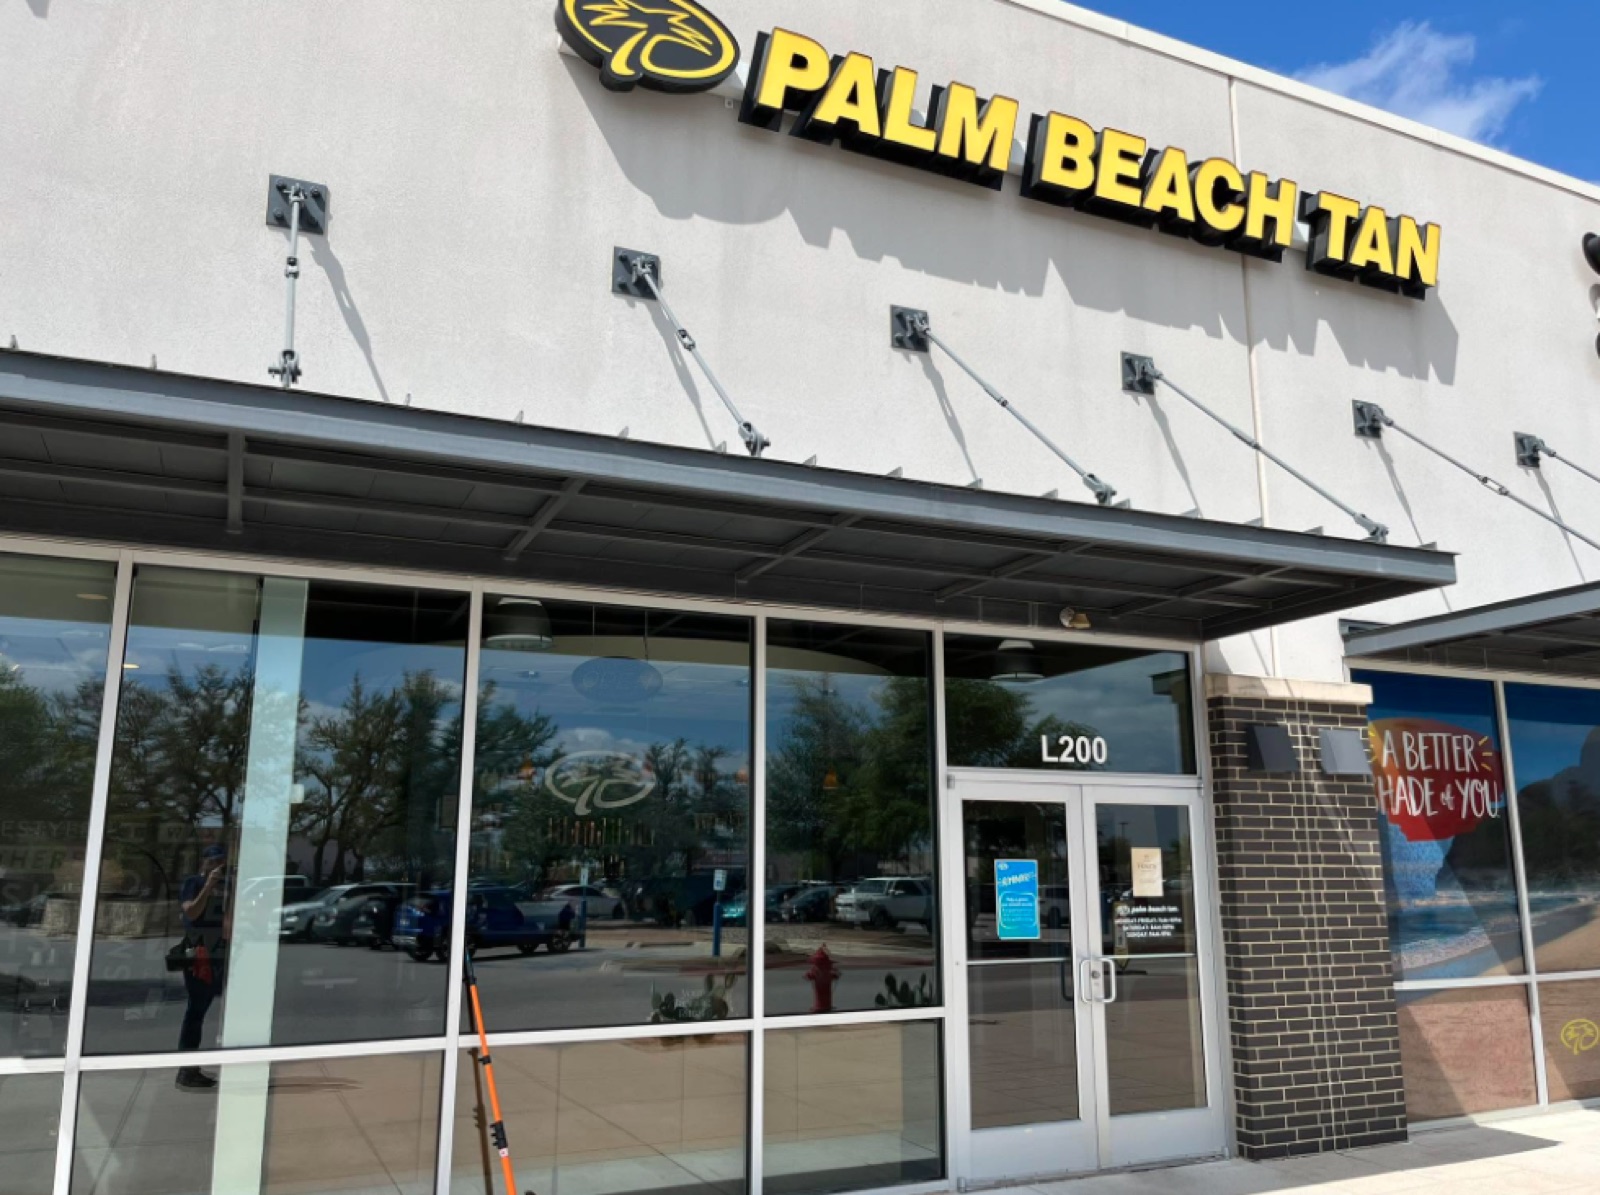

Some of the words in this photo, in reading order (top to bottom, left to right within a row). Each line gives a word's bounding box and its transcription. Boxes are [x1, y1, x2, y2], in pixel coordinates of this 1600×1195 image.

[756, 26, 1020, 172] PALM
[1040, 110, 1297, 247] BEACH
[1317, 190, 1441, 288] TAN
[1040, 734, 1108, 764] L200
[1382, 729, 1399, 768] A
[1402, 730, 1479, 772] BETTER
[1377, 774, 1438, 816] HADE
[1455, 778, 1499, 819] YOU
